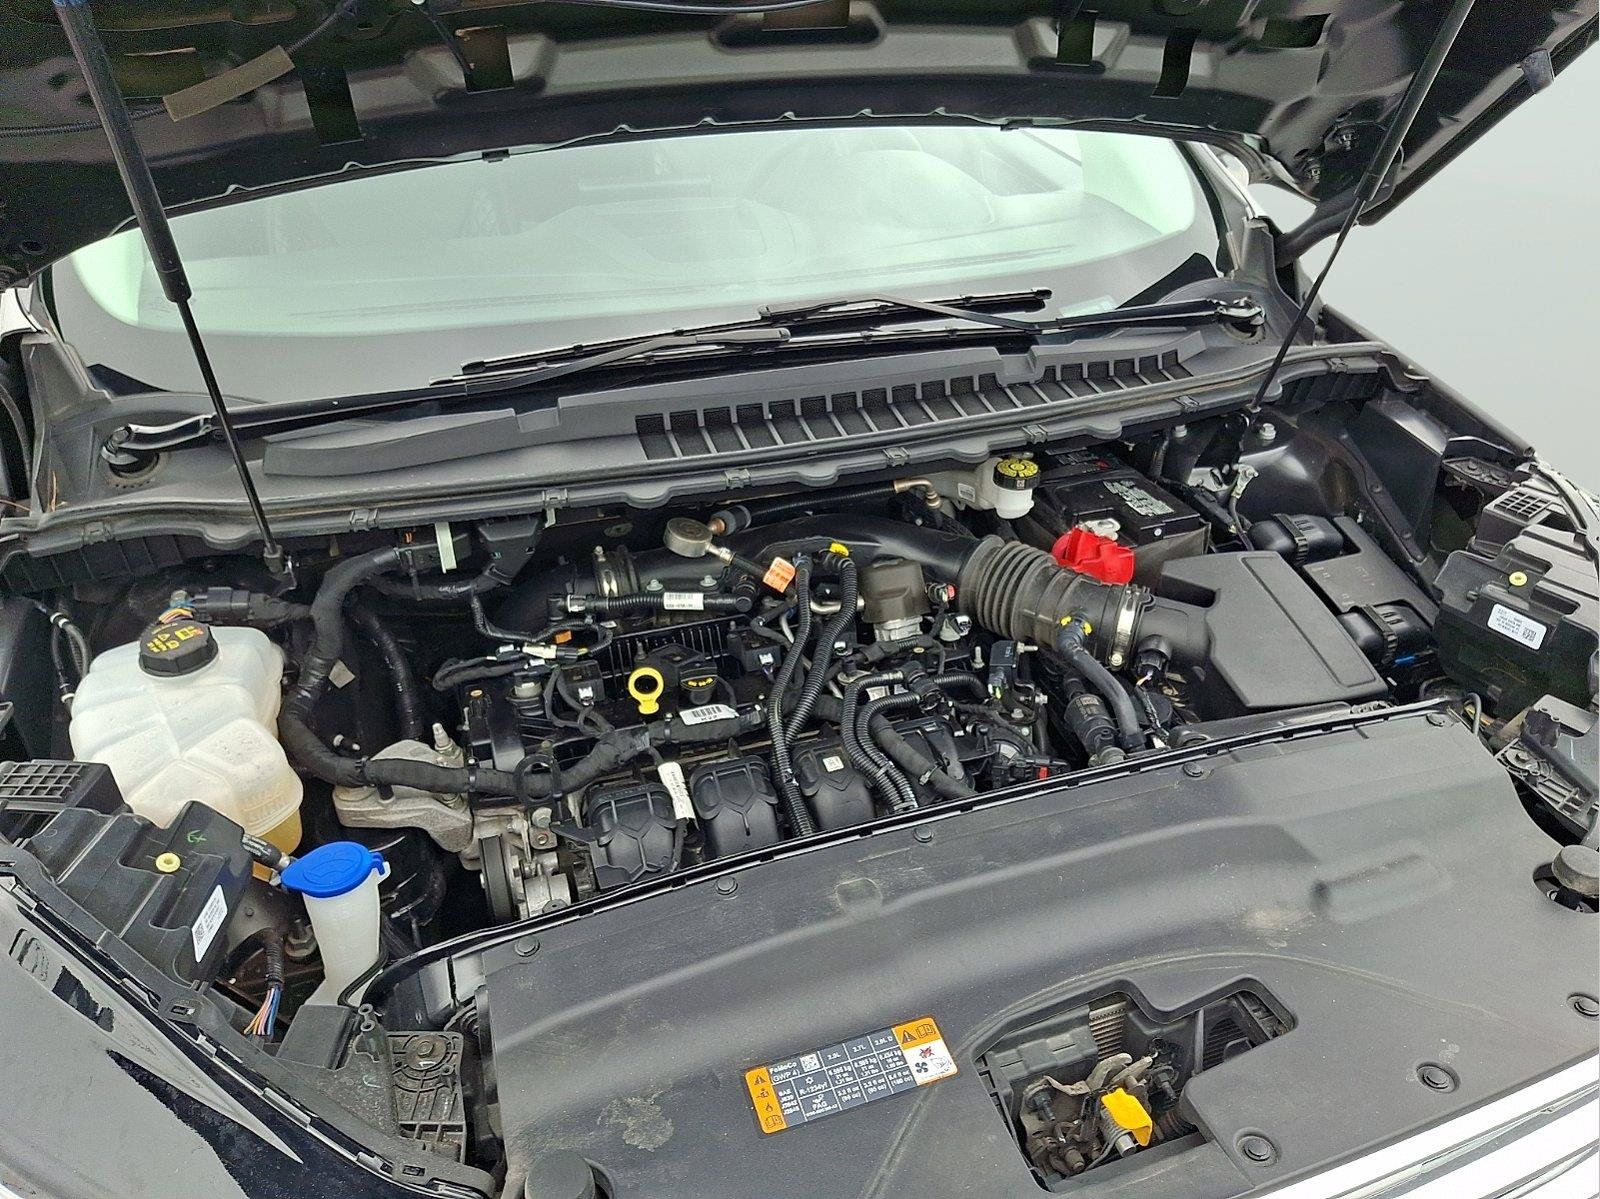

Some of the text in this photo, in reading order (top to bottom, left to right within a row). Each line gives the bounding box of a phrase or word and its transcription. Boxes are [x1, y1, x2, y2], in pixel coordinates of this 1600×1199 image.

[852, 1044, 866, 1052] 2.7L
[769, 1061, 797, 1074] FoMoCo
[798, 1081, 828, 1096] R-1234yf
[811, 1100, 827, 1110] PAG
